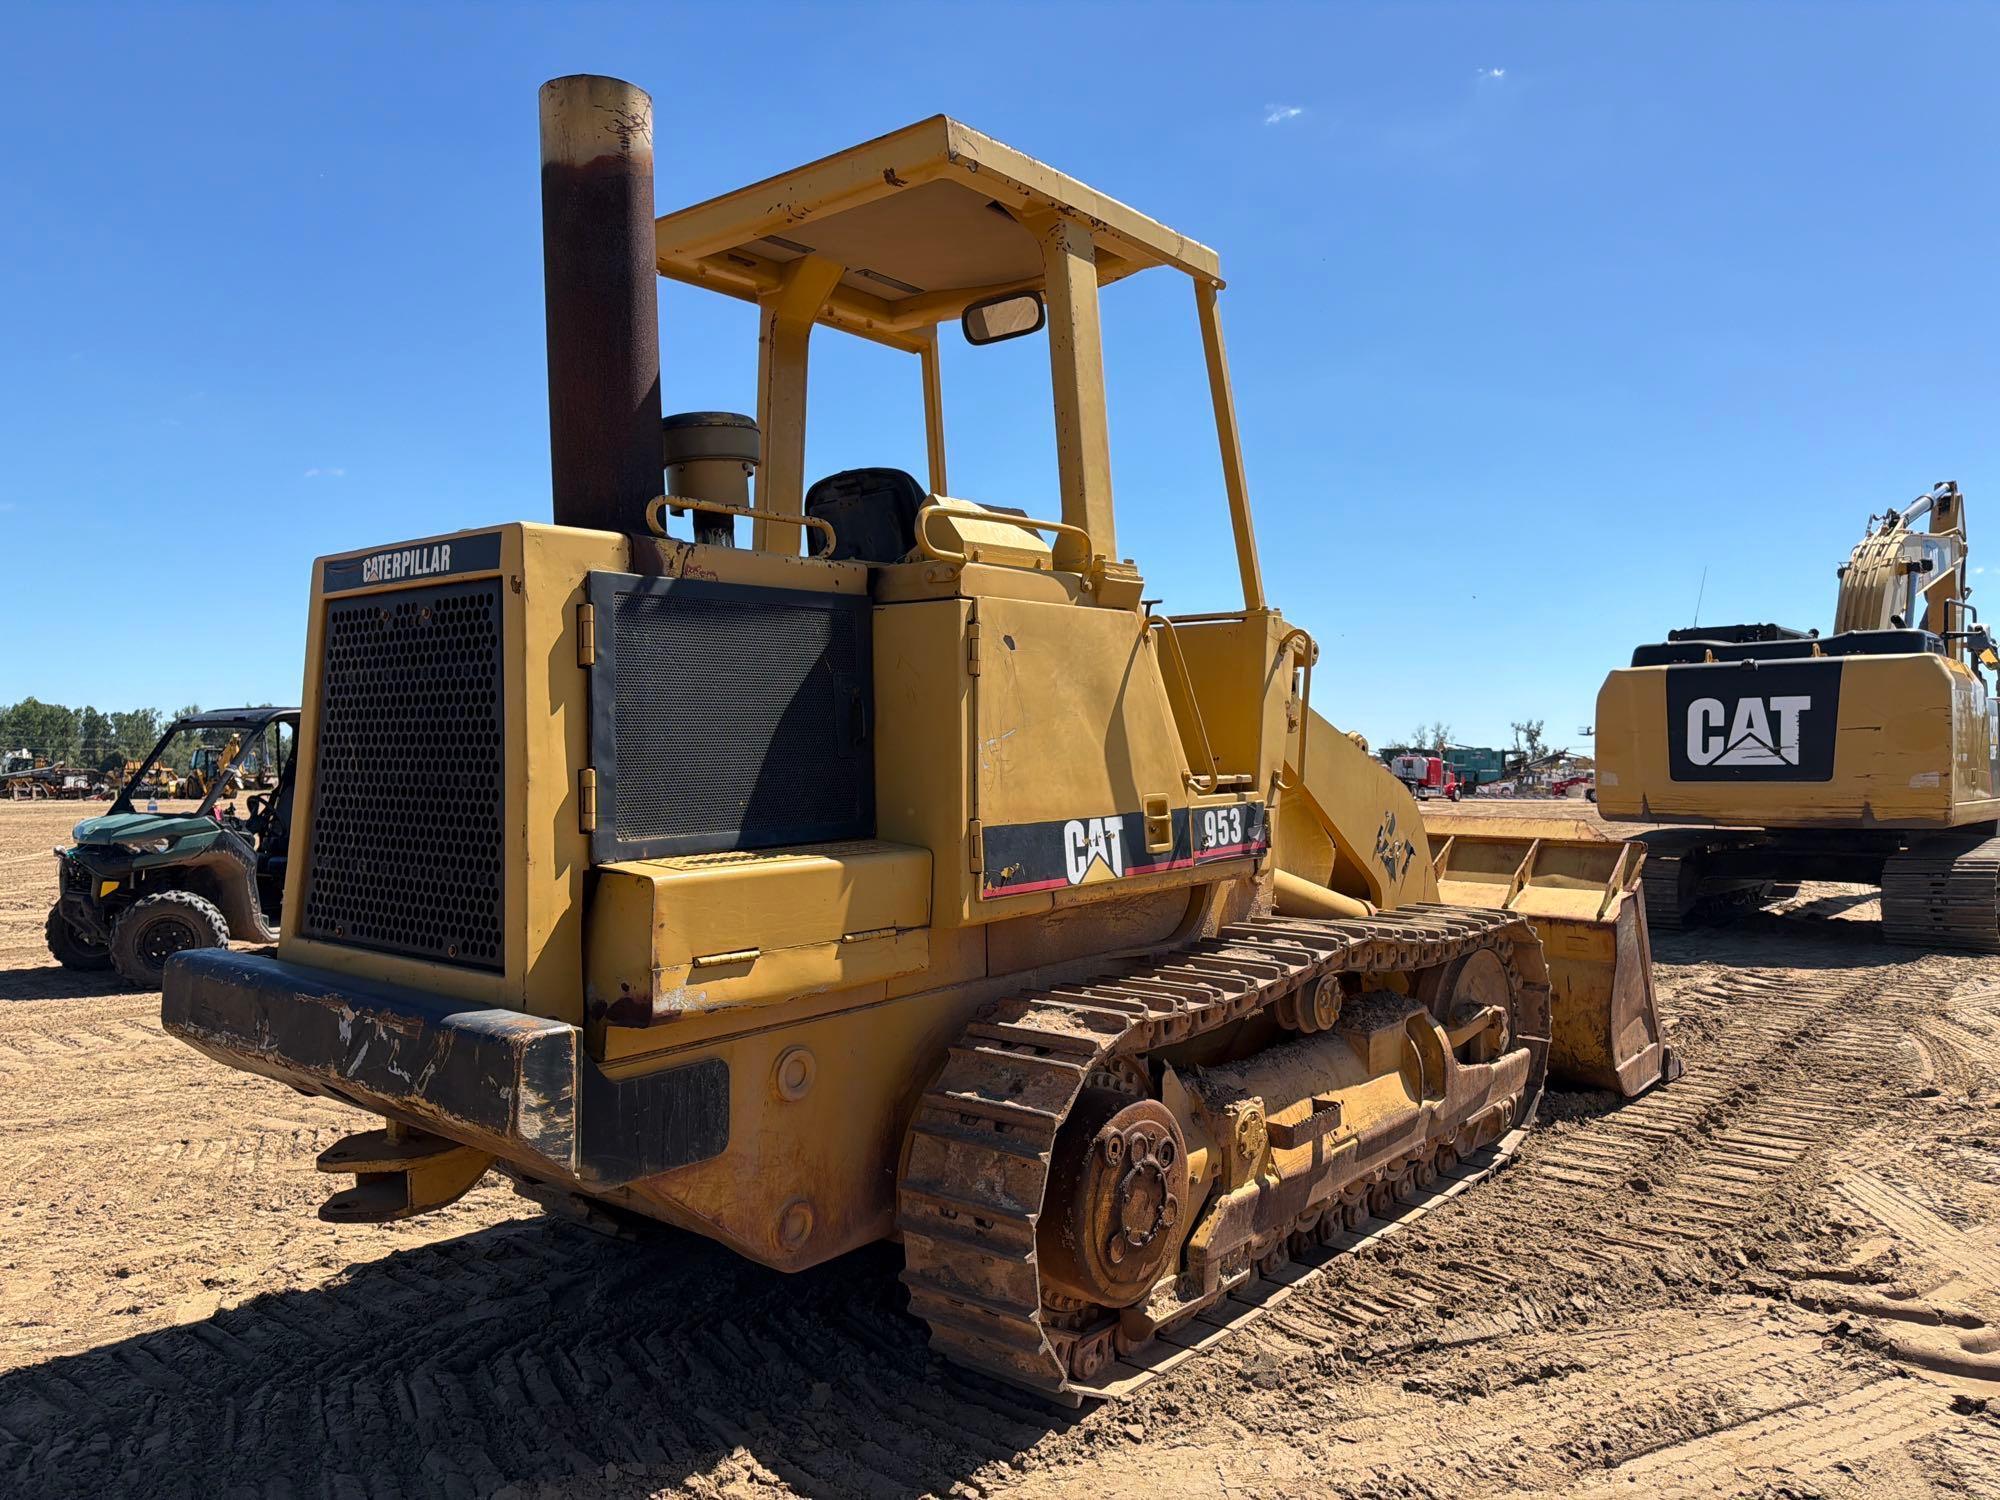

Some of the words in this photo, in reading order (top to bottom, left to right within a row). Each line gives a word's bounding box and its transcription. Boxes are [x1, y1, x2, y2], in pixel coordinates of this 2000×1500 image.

[362, 544, 451, 583] CATERPILLAR
[1687, 695, 1811, 766] CAT
[1063, 815, 1124, 885] CAT
[1204, 807, 1242, 848] 953
